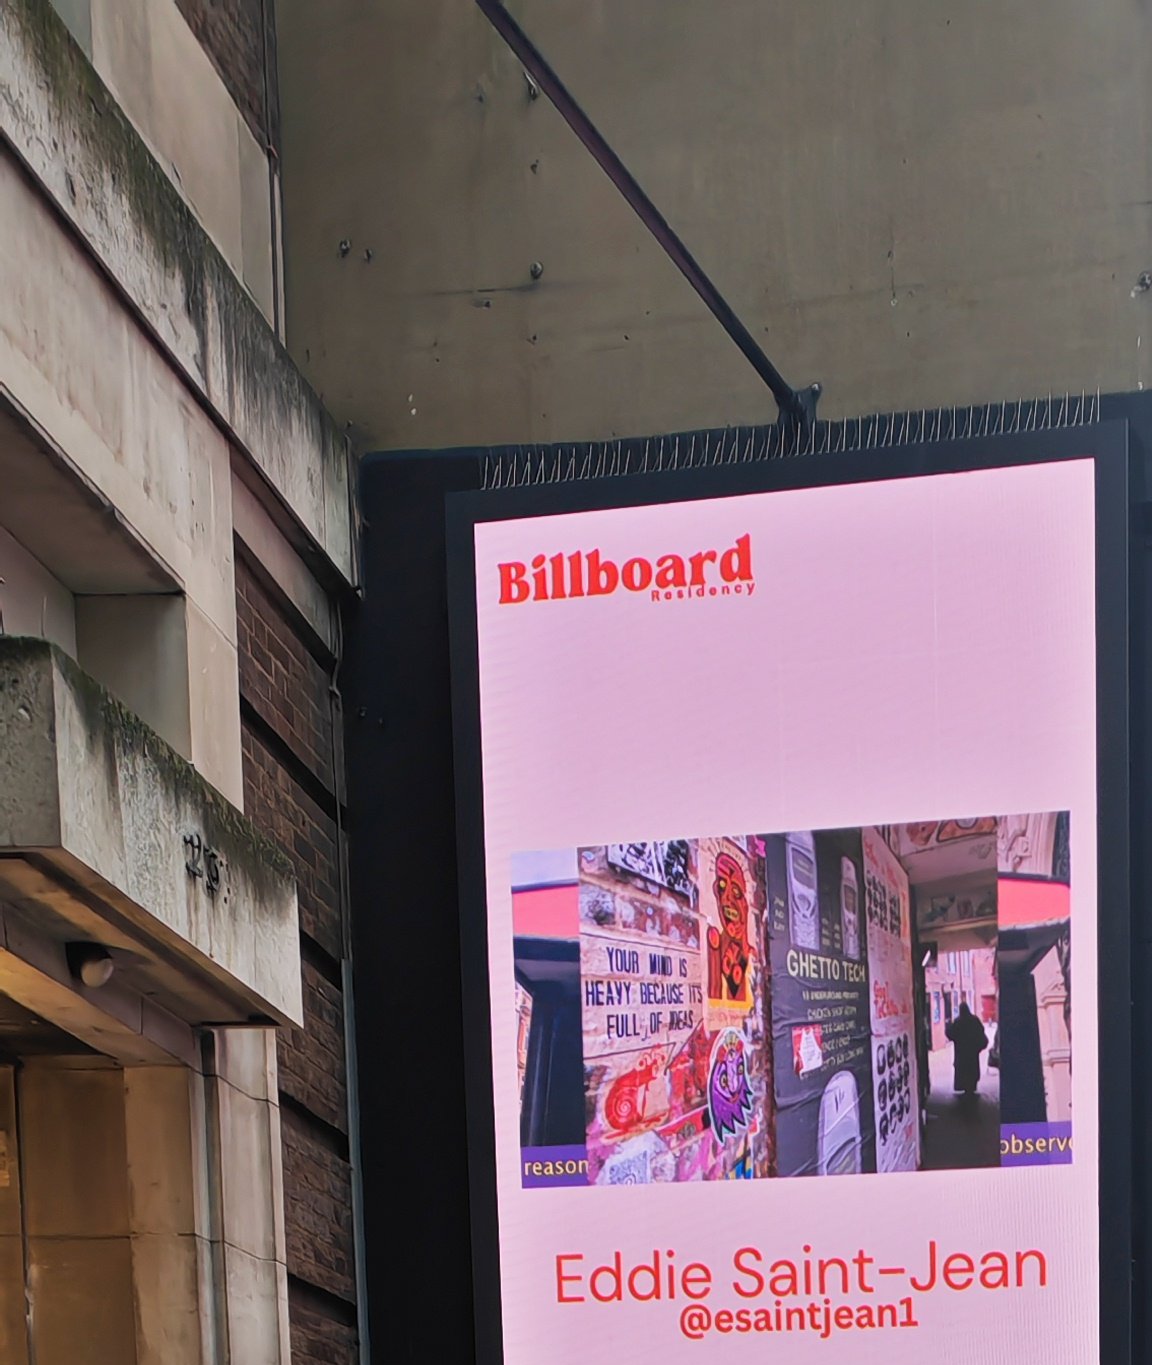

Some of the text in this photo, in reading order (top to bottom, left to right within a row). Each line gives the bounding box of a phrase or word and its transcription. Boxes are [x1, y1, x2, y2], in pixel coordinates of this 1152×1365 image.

[498, 533, 753, 604] Billboard
[651, 582, 755, 602] Residency
[606, 947, 688, 978] YOUR MIND IS
[787, 949, 866, 982] GHETTO TECH
[585, 980, 631, 1006] HEAVY
[640, 982, 684, 1005] BECAUSE
[606, 1010, 693, 1040] FULL OF IDEAS
[556, 1240, 1047, 1302] Eddie Saint-Jean
[680, 1297, 918, 1339] @esaintjean1
